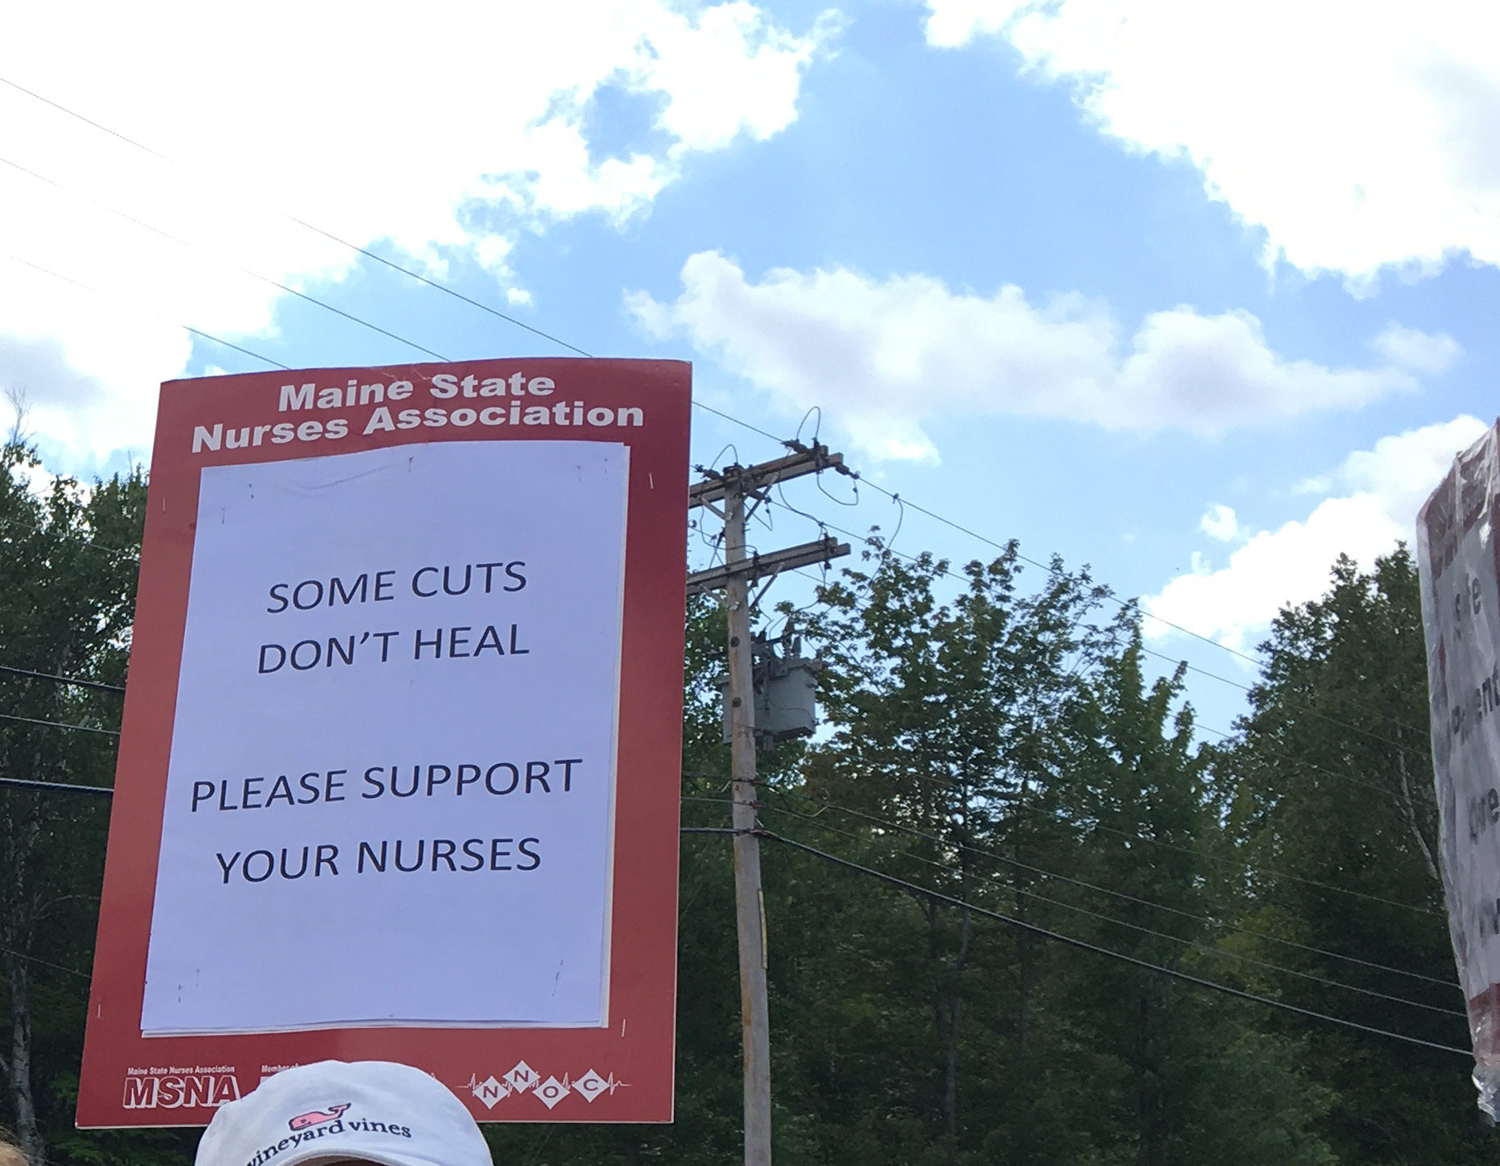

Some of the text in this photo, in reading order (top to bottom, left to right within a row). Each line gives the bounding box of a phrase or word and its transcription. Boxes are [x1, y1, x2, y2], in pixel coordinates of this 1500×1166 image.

[279, 371, 556, 412] Maine State
[191, 400, 644, 454] Nurses Association
[266, 560, 527, 614] SOME CUTS
[258, 623, 530, 674] DON’T HEAL
[191, 758, 583, 813] PLEASE SUPPORT
[215, 837, 541, 885] YOUR NURSES
[122, 1075, 242, 1109] MSNA
[348, 1117, 412, 1139] vines
